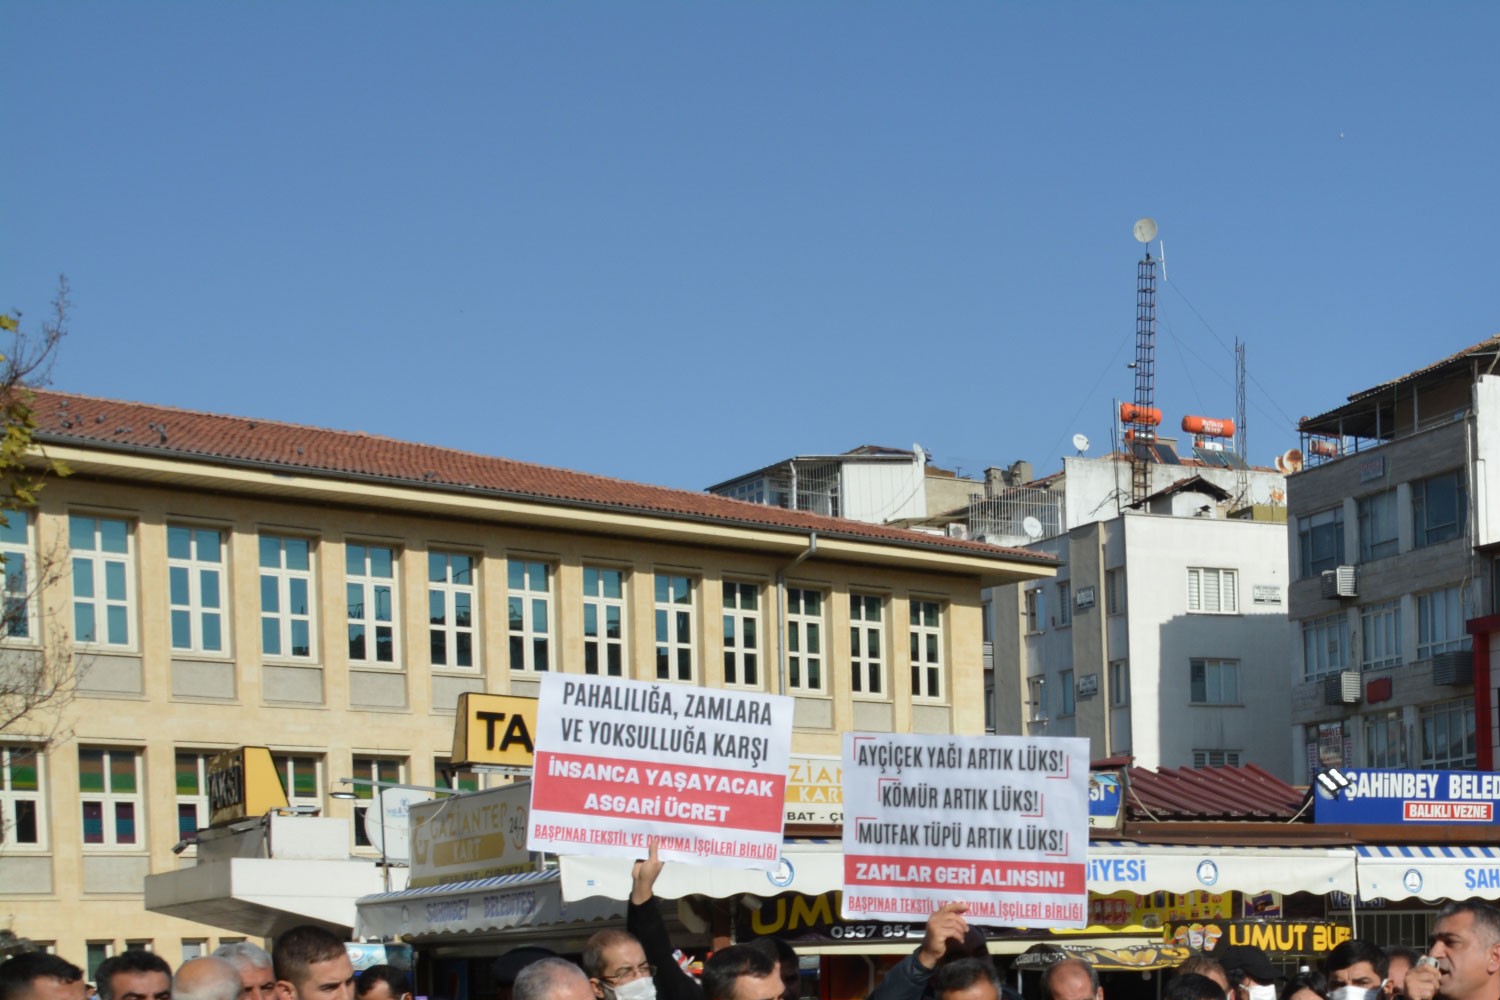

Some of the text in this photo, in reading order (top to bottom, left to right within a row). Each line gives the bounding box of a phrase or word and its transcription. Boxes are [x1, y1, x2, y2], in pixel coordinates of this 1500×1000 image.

[563, 681, 773, 726] PAHALILIĞA, ZAMLARA
[476, 711, 535, 754] TA
[561, 717, 769, 768] VE YOKSULLUĞA KARŞI
[858, 741, 1065, 774] AYÇİÇEK YAĞI ARTIK LÜKS!
[548, 755, 775, 798] İNSANCA YAŞAYACAK
[583, 793, 731, 823] ASGARİ ÜCRET
[882, 782, 1038, 813] KÖMÜR ARTIK LÜKS!
[1408, 804, 1488, 819] BALIKLI VEZNE
[786, 811, 815, 821] BAT
[534, 824, 778, 860] BAŞPINAR TEKSTİL VE DOKUMA İŞÇİLERİ BİRLİĞİ
[858, 821, 1064, 852] MUTFAK TÜPÜ ARTIK LÜKS!
[855, 863, 1066, 888] ZAMLAR GERİ ALINSIN!
[848, 896, 898, 915] BAŞPINAR
[900, 896, 934, 914] TEKSTİL
[951, 901, 996, 917] KUMA
[999, 899, 1042, 921] İŞÇİLERİ
[1045, 901, 1084, 921] BİRLİĞİ
[830, 925, 877, 939] 0537
[1229, 923, 1308, 952] UMUT
